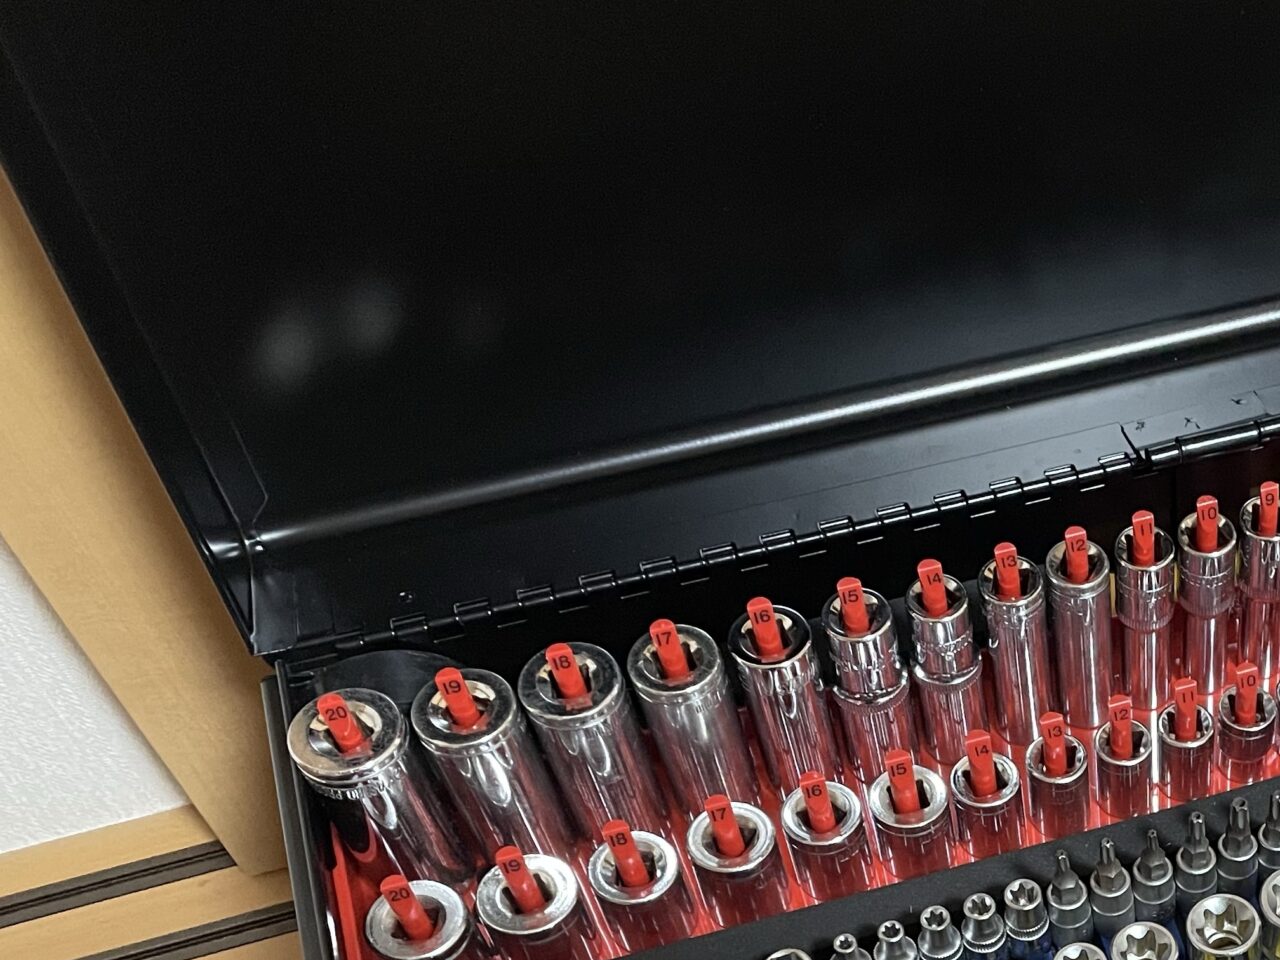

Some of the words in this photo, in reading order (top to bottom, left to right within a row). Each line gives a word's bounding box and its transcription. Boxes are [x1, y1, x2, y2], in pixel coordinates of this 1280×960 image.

[1265, 493, 1275, 506] 9
[1201, 506, 1217, 521] 10
[1140, 521, 1153, 536] 11
[1070, 539, 1085, 552] 12
[1001, 555, 1017, 568] 13
[926, 572, 942, 586] 14
[842, 589, 859, 604] 15
[753, 609, 772, 624] 16
[655, 631, 673, 647] 17
[553, 655, 571, 670] 18
[442, 679, 462, 695] 19
[1241, 674, 1256, 688] 10
[1181, 690, 1194, 703] 11
[325, 706, 348, 721] 20
[1113, 708, 1128, 721] 12
[1047, 725, 1063, 737] 13
[975, 744, 989, 756] 14
[890, 762, 907, 777] 15
[805, 784, 822, 798] 16
[710, 807, 727, 822] 17
[609, 832, 627, 847] 18
[502, 859, 520, 873] 19
[389, 887, 410, 900] 20
